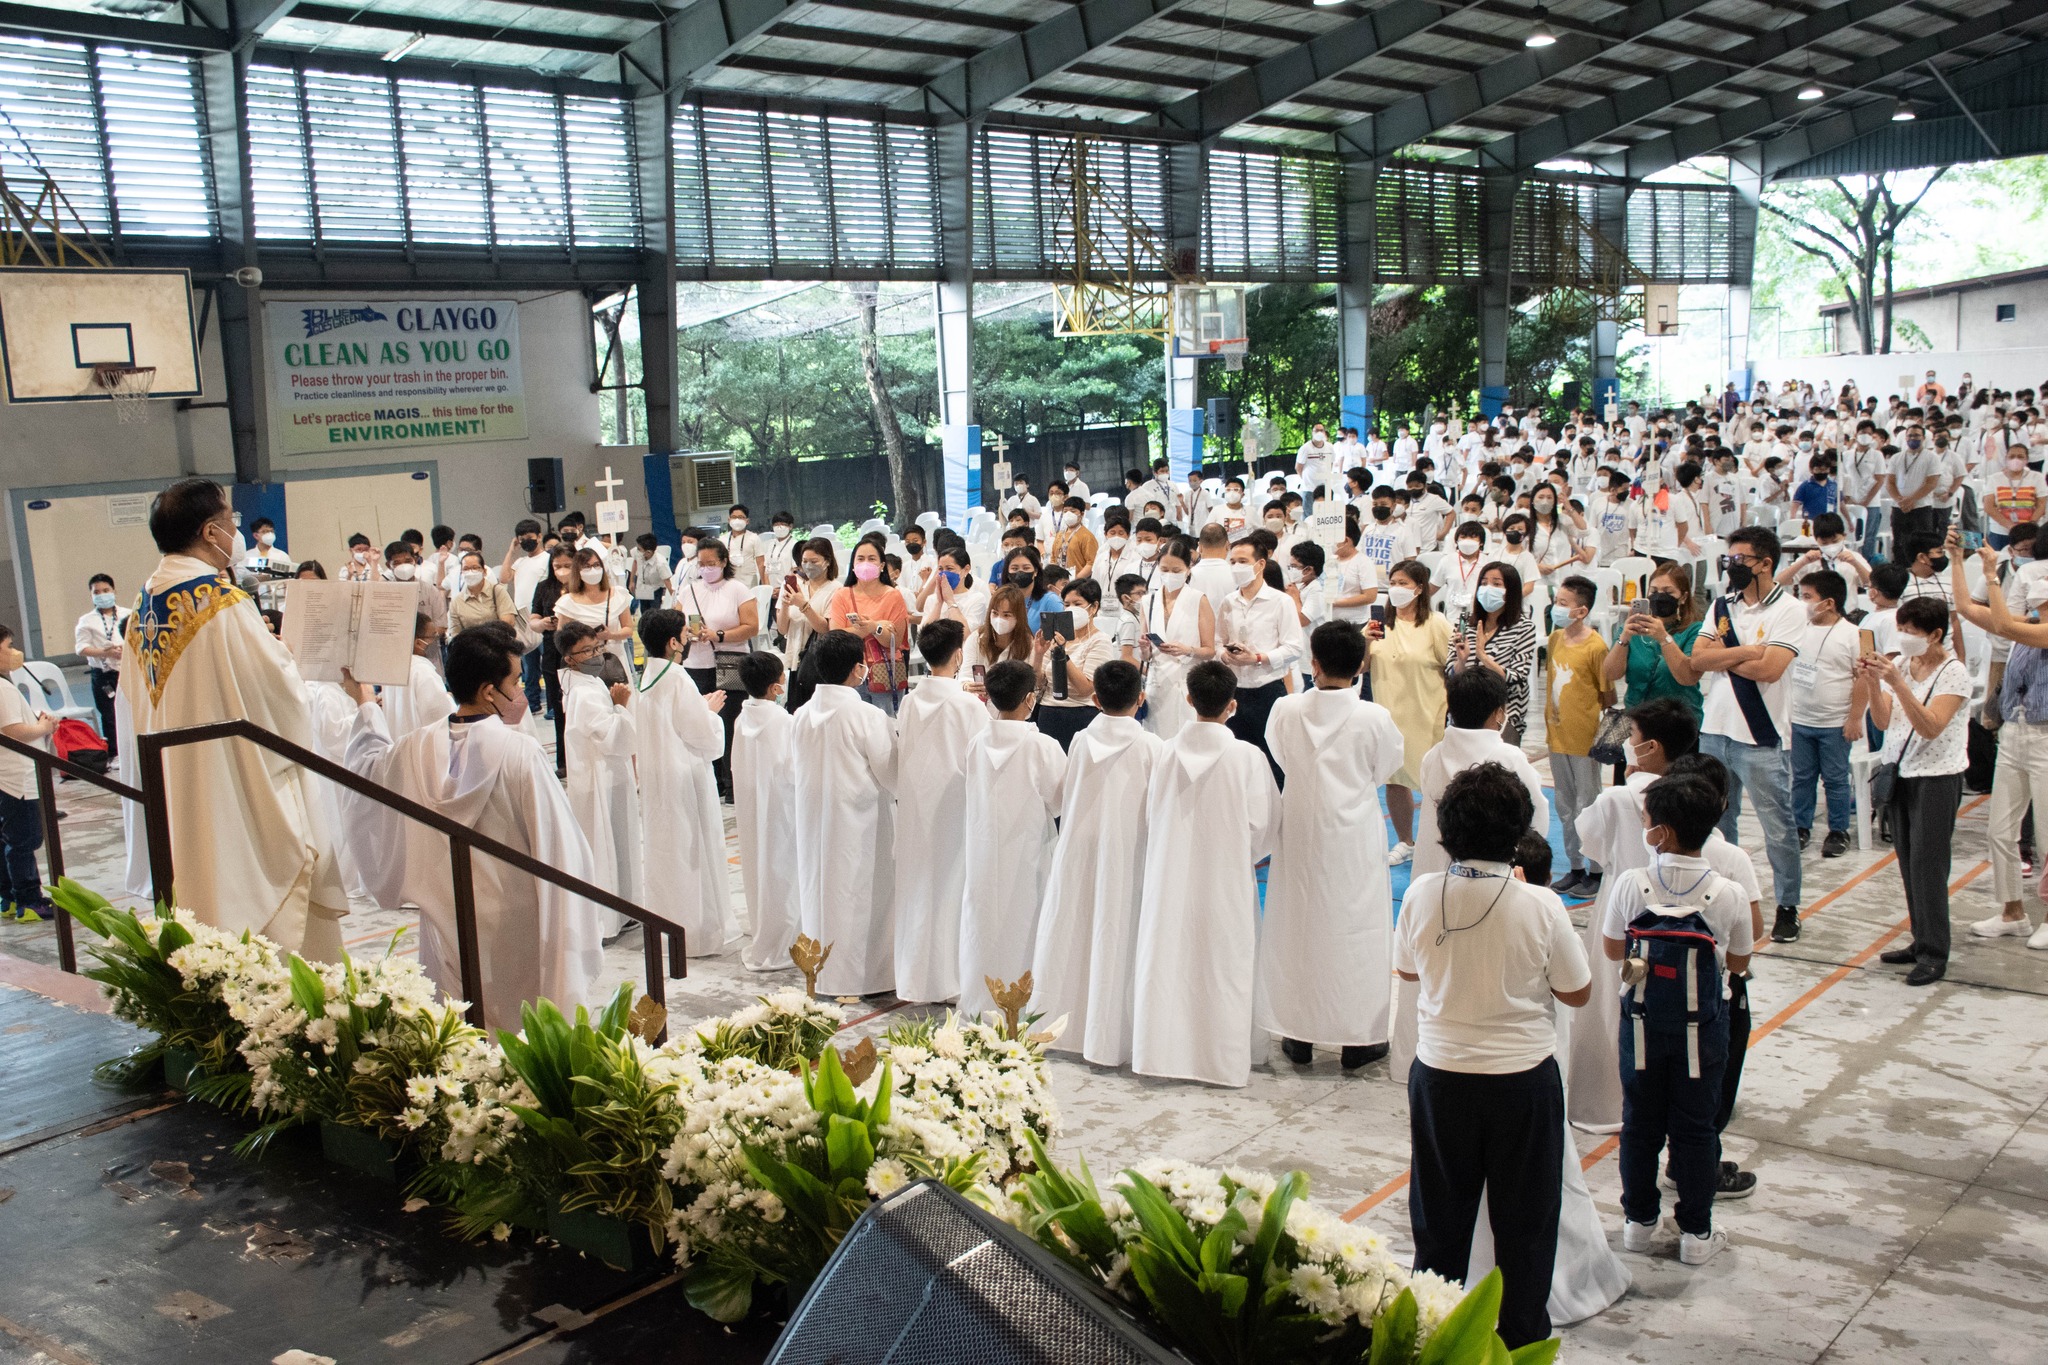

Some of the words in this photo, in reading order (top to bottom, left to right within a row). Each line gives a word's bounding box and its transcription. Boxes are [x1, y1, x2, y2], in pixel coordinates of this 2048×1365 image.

[312, 309, 349, 324] BLUE
[332, 313, 364, 329] GREEN
[397, 307, 497, 331] CLAYGO
[284, 342, 368, 366] CLEAN
[380, 341, 410, 364] AS
[419, 340, 467, 363] YOU
[478, 339, 510, 361] GO
[291, 374, 329, 387] Please
[332, 373, 364, 386] throw
[366, 373, 391, 388] your
[394, 370, 420, 384] trash
[423, 370, 433, 382] in
[436, 369, 452, 382] the
[455, 370, 488, 383] proper
[490, 368, 509, 380] bin.
[294, 391, 329, 400] Practice
[330, 390, 376, 399] cleanliness
[378, 388, 393, 397] and
[395, 386, 447, 398] responsibility
[449, 384, 483, 394] wherever
[497, 384, 509, 393] go.
[293, 413, 322, 425] Let's
[325, 411, 371, 426] practice
[432, 406, 453, 418] this
[455, 405, 478, 416] time
[480, 404, 495, 415] for
[497, 403, 514, 414] the
[328, 420, 486, 443] ENVIRONMENT!
[1316, 515, 1343, 525] BAGOBO
[1366, 548, 1391, 560] BIG
